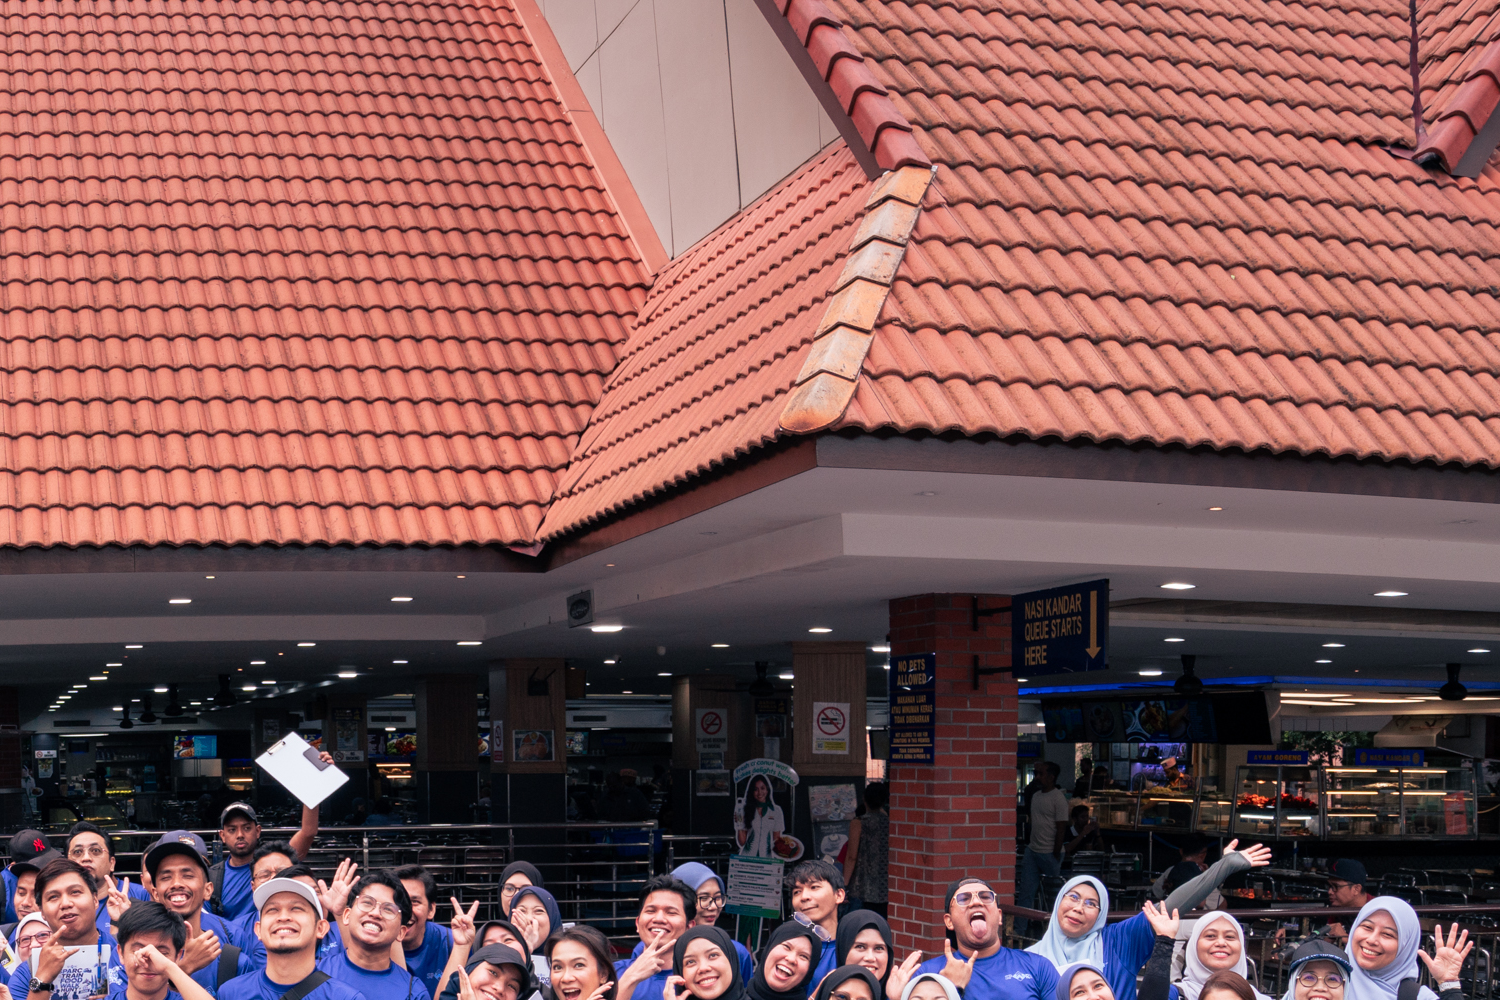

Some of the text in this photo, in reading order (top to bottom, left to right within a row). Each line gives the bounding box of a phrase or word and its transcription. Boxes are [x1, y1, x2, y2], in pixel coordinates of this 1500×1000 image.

[1025, 593, 1082, 619] NASI KANDAR
[1025, 616, 1082, 642] QUEUE STARTS
[1025, 645, 1047, 666] HERE
[898, 659, 925, 672] NO PETS
[897, 673, 926, 686] ALLOWED
[736, 764, 749, 774] Fresh
[778, 771, 796, 785] better
